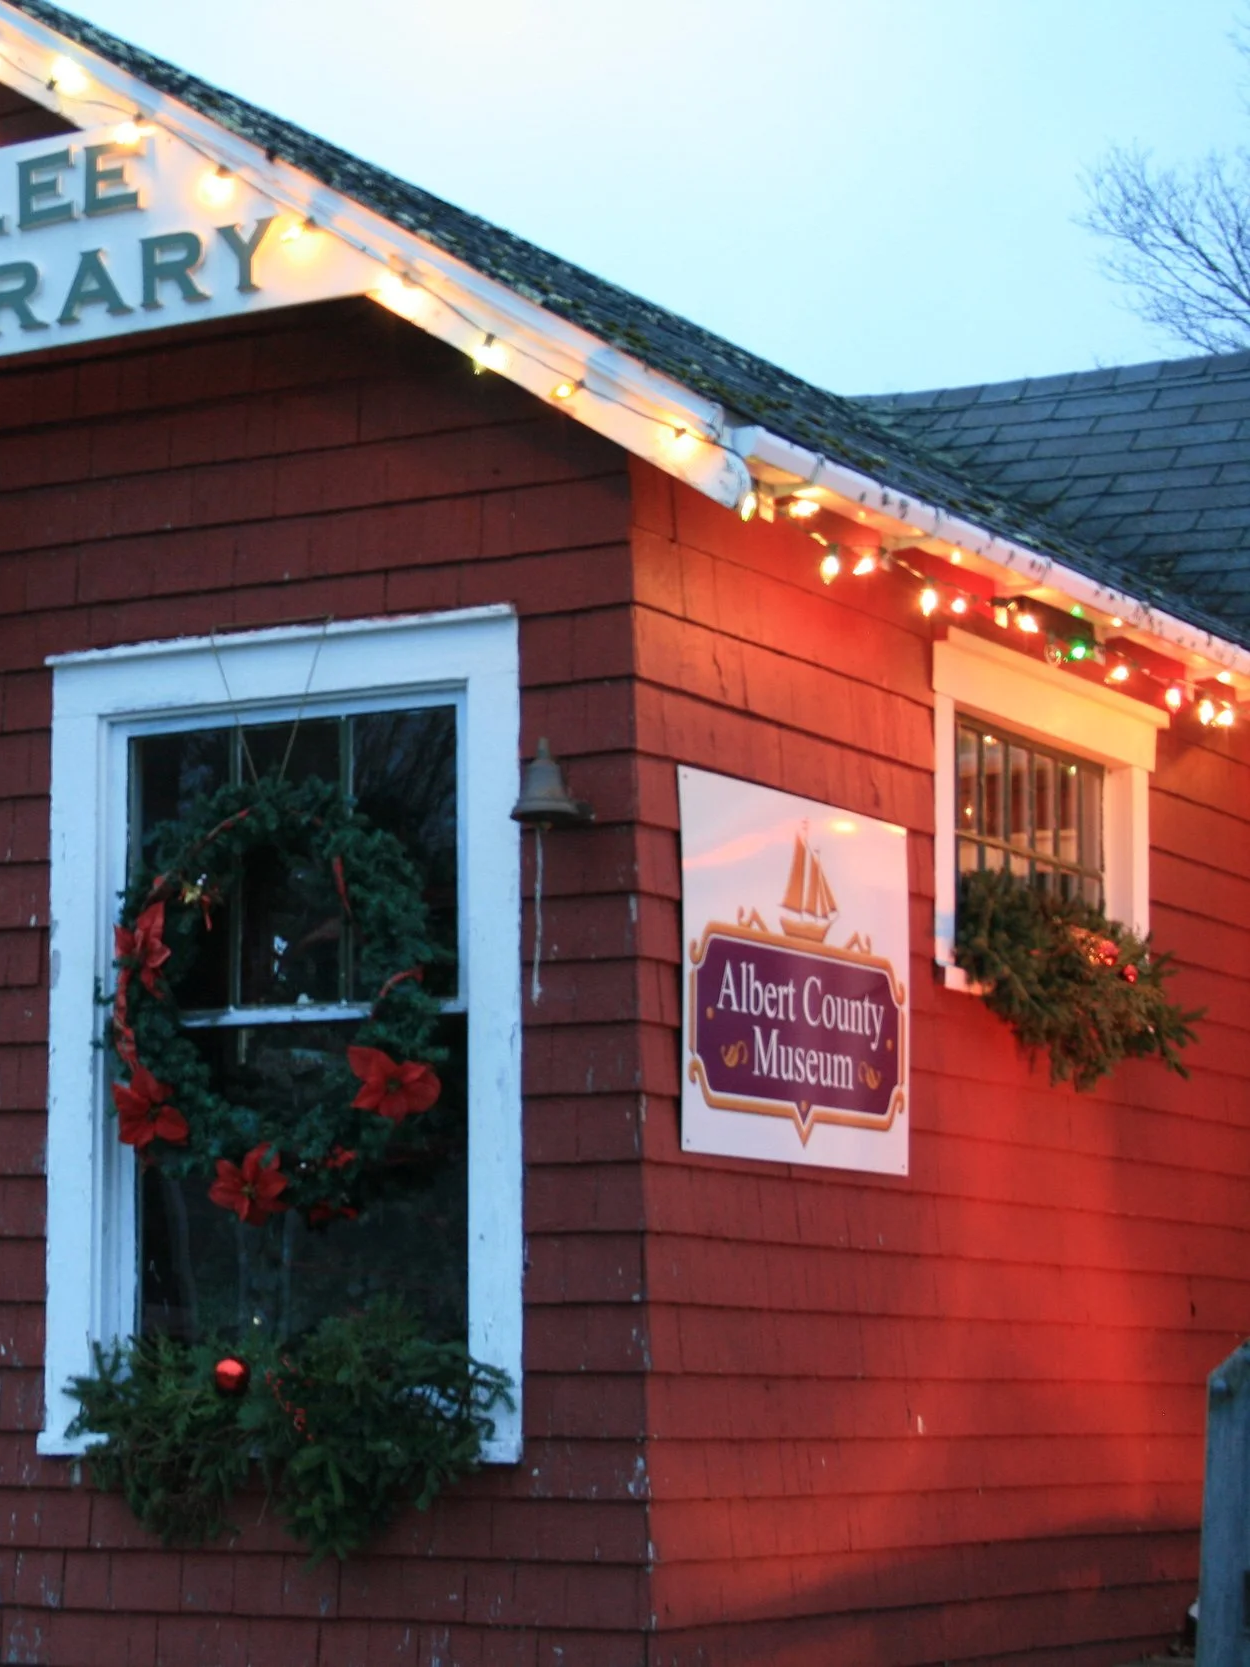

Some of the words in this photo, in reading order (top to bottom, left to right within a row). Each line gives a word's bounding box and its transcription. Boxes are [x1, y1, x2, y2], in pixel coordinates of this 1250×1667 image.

[717, 959, 797, 1022] Albert
[802, 975, 885, 1052] County
[752, 1025, 855, 1090] Museum
